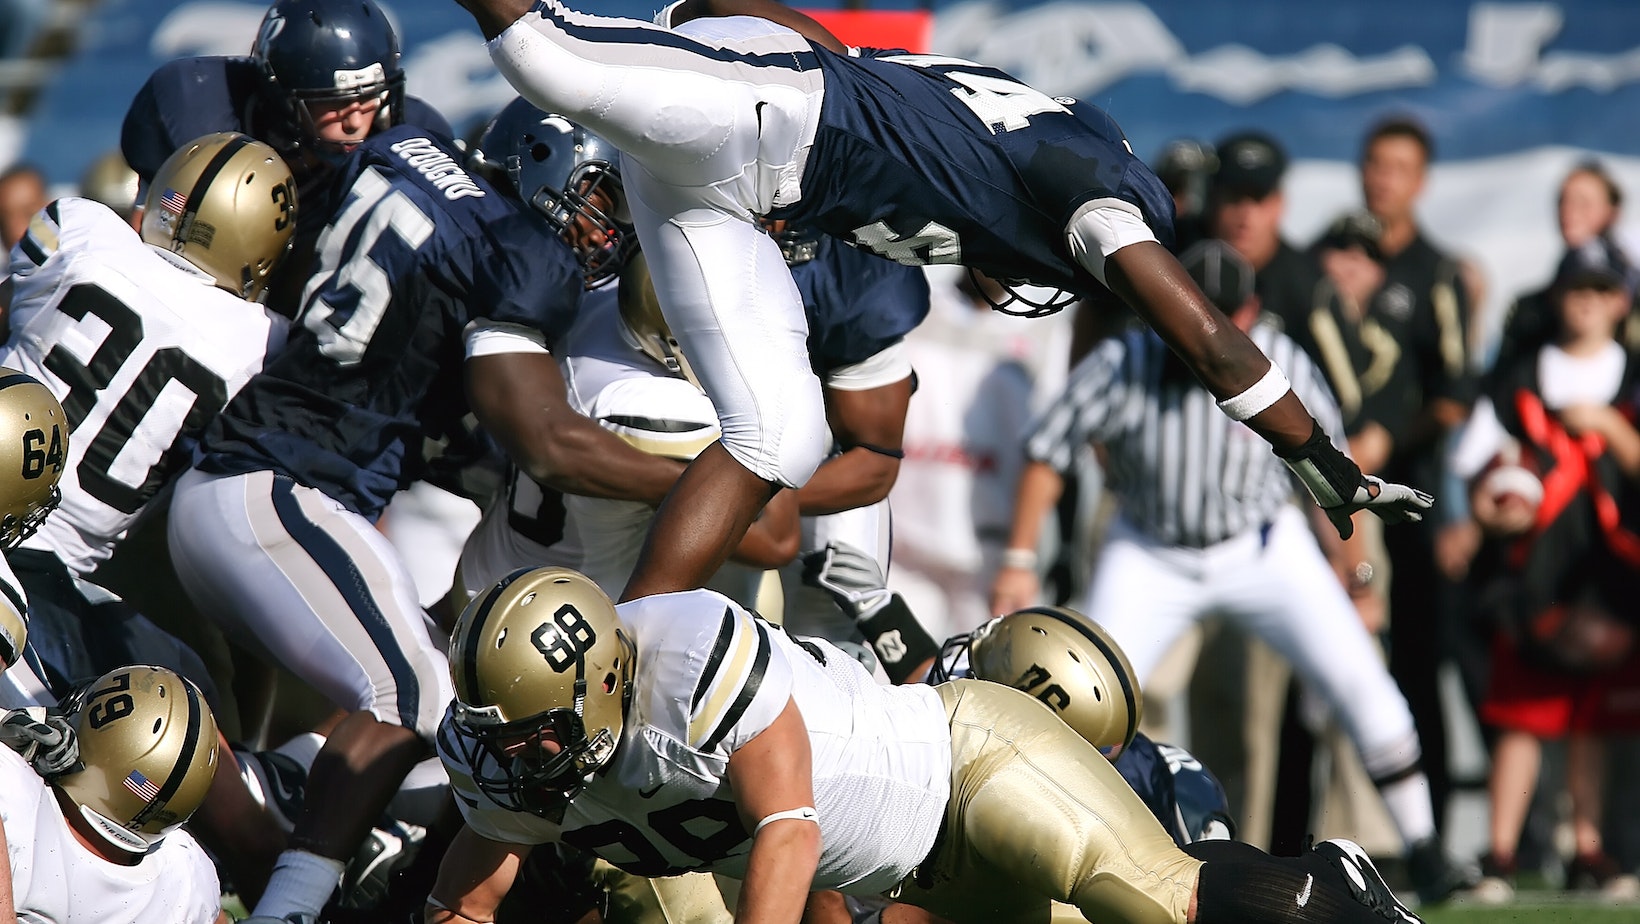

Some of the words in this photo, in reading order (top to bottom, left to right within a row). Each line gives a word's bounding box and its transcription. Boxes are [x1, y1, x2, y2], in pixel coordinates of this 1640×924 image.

[43, 281, 229, 514] 30
[21, 423, 63, 480] 64
[531, 603, 597, 674] 88
[86, 672, 135, 730] 79
